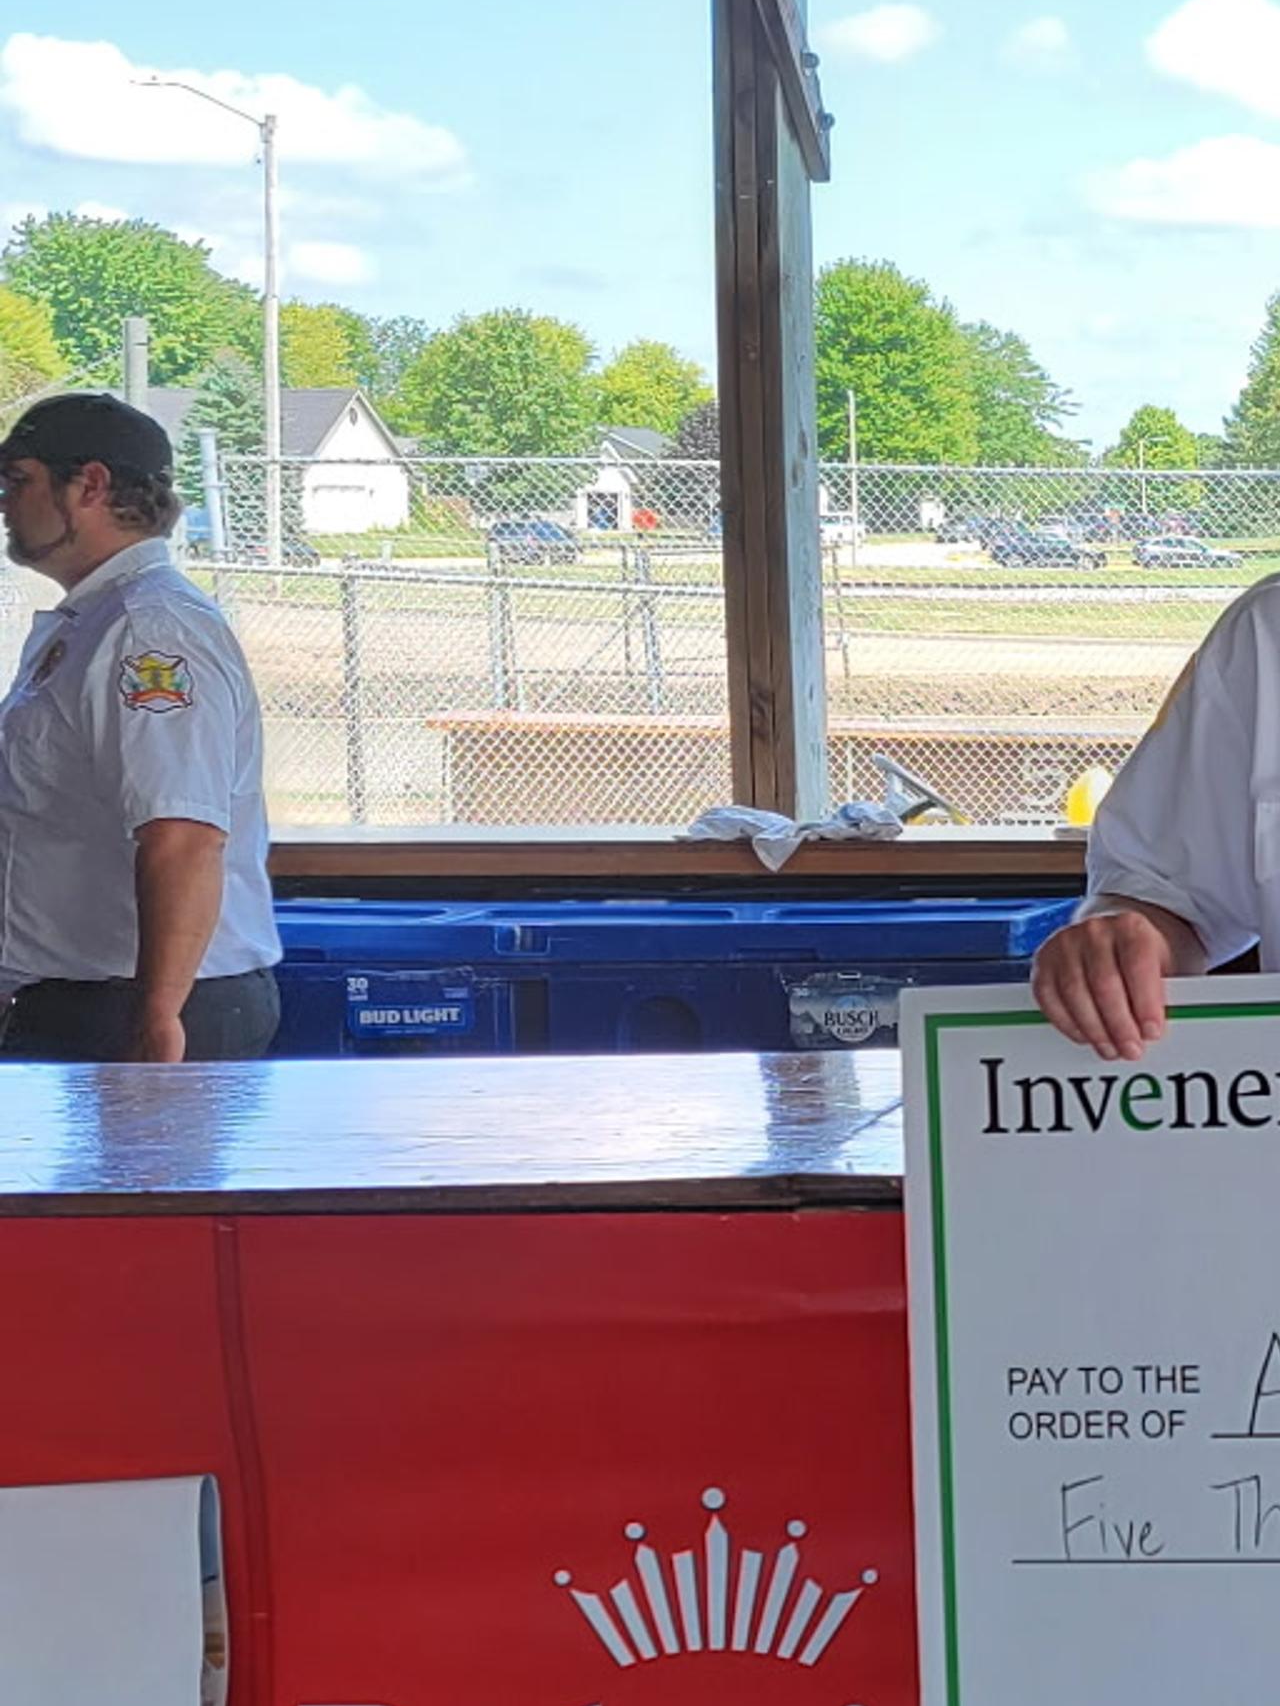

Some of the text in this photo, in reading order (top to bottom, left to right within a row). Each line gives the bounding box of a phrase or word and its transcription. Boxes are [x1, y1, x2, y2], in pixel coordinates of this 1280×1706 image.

[359, 1007, 461, 1024] BUD LIGHT
[824, 1010, 878, 1026] BUSCH
[1007, 1364, 1201, 1395] PAY TO THE
[1008, 1409, 1187, 1440] ORDER OF
[1061, 1474, 1166, 1560] Five
